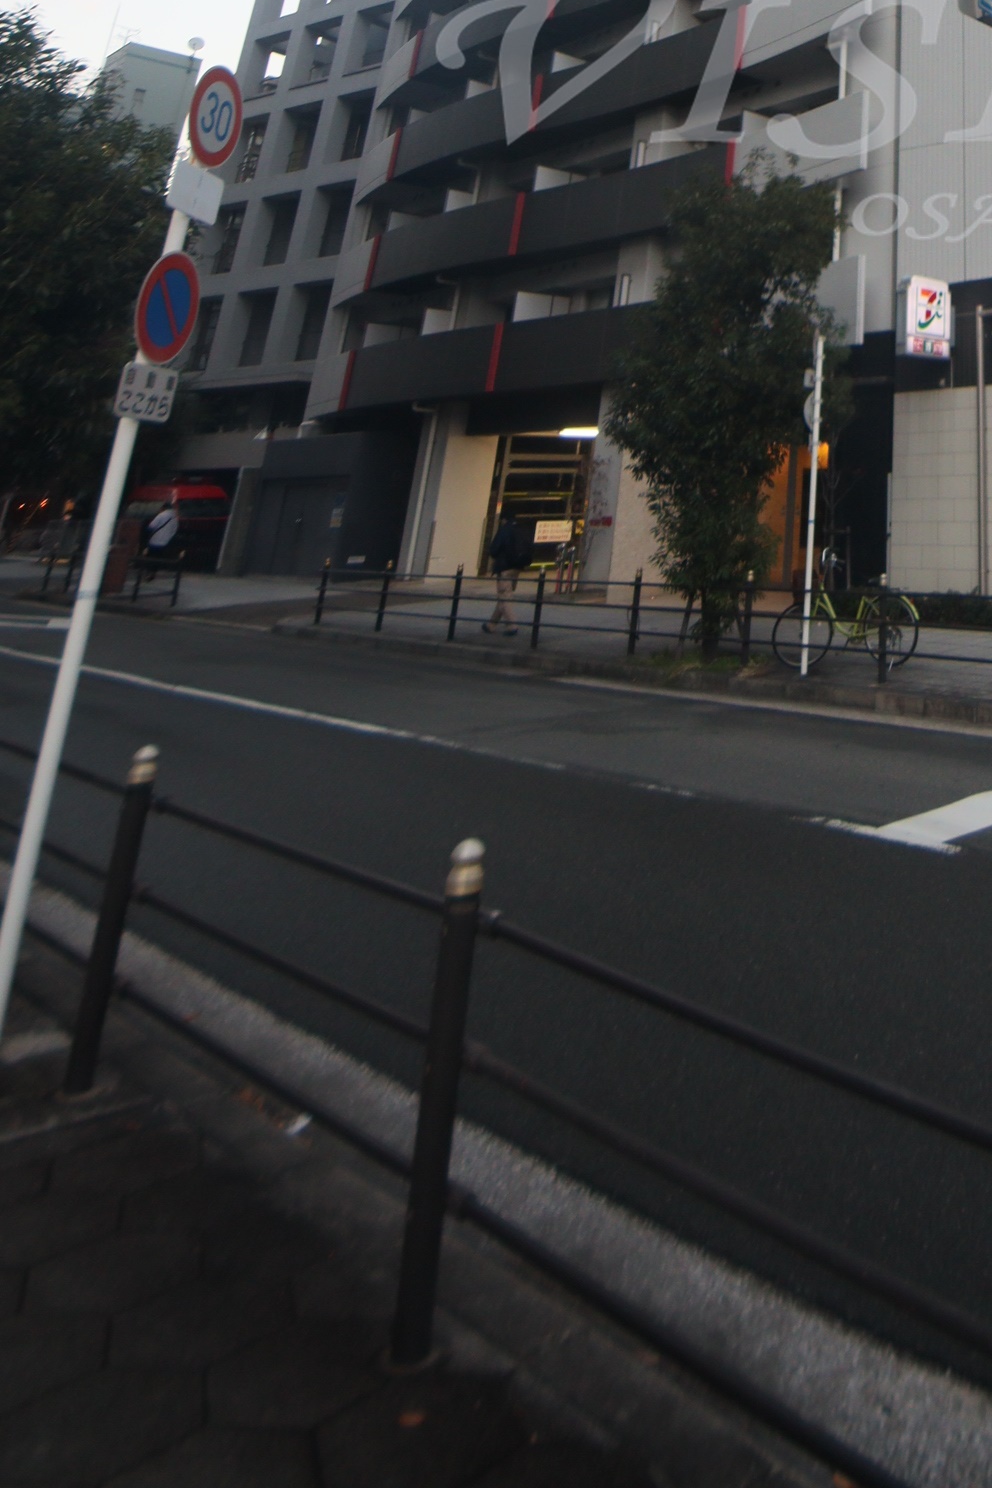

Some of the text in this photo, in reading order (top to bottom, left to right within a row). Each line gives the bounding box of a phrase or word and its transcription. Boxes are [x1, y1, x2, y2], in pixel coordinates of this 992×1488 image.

[201, 91, 232, 141] 30
[119, 390, 169, 417] ここから
